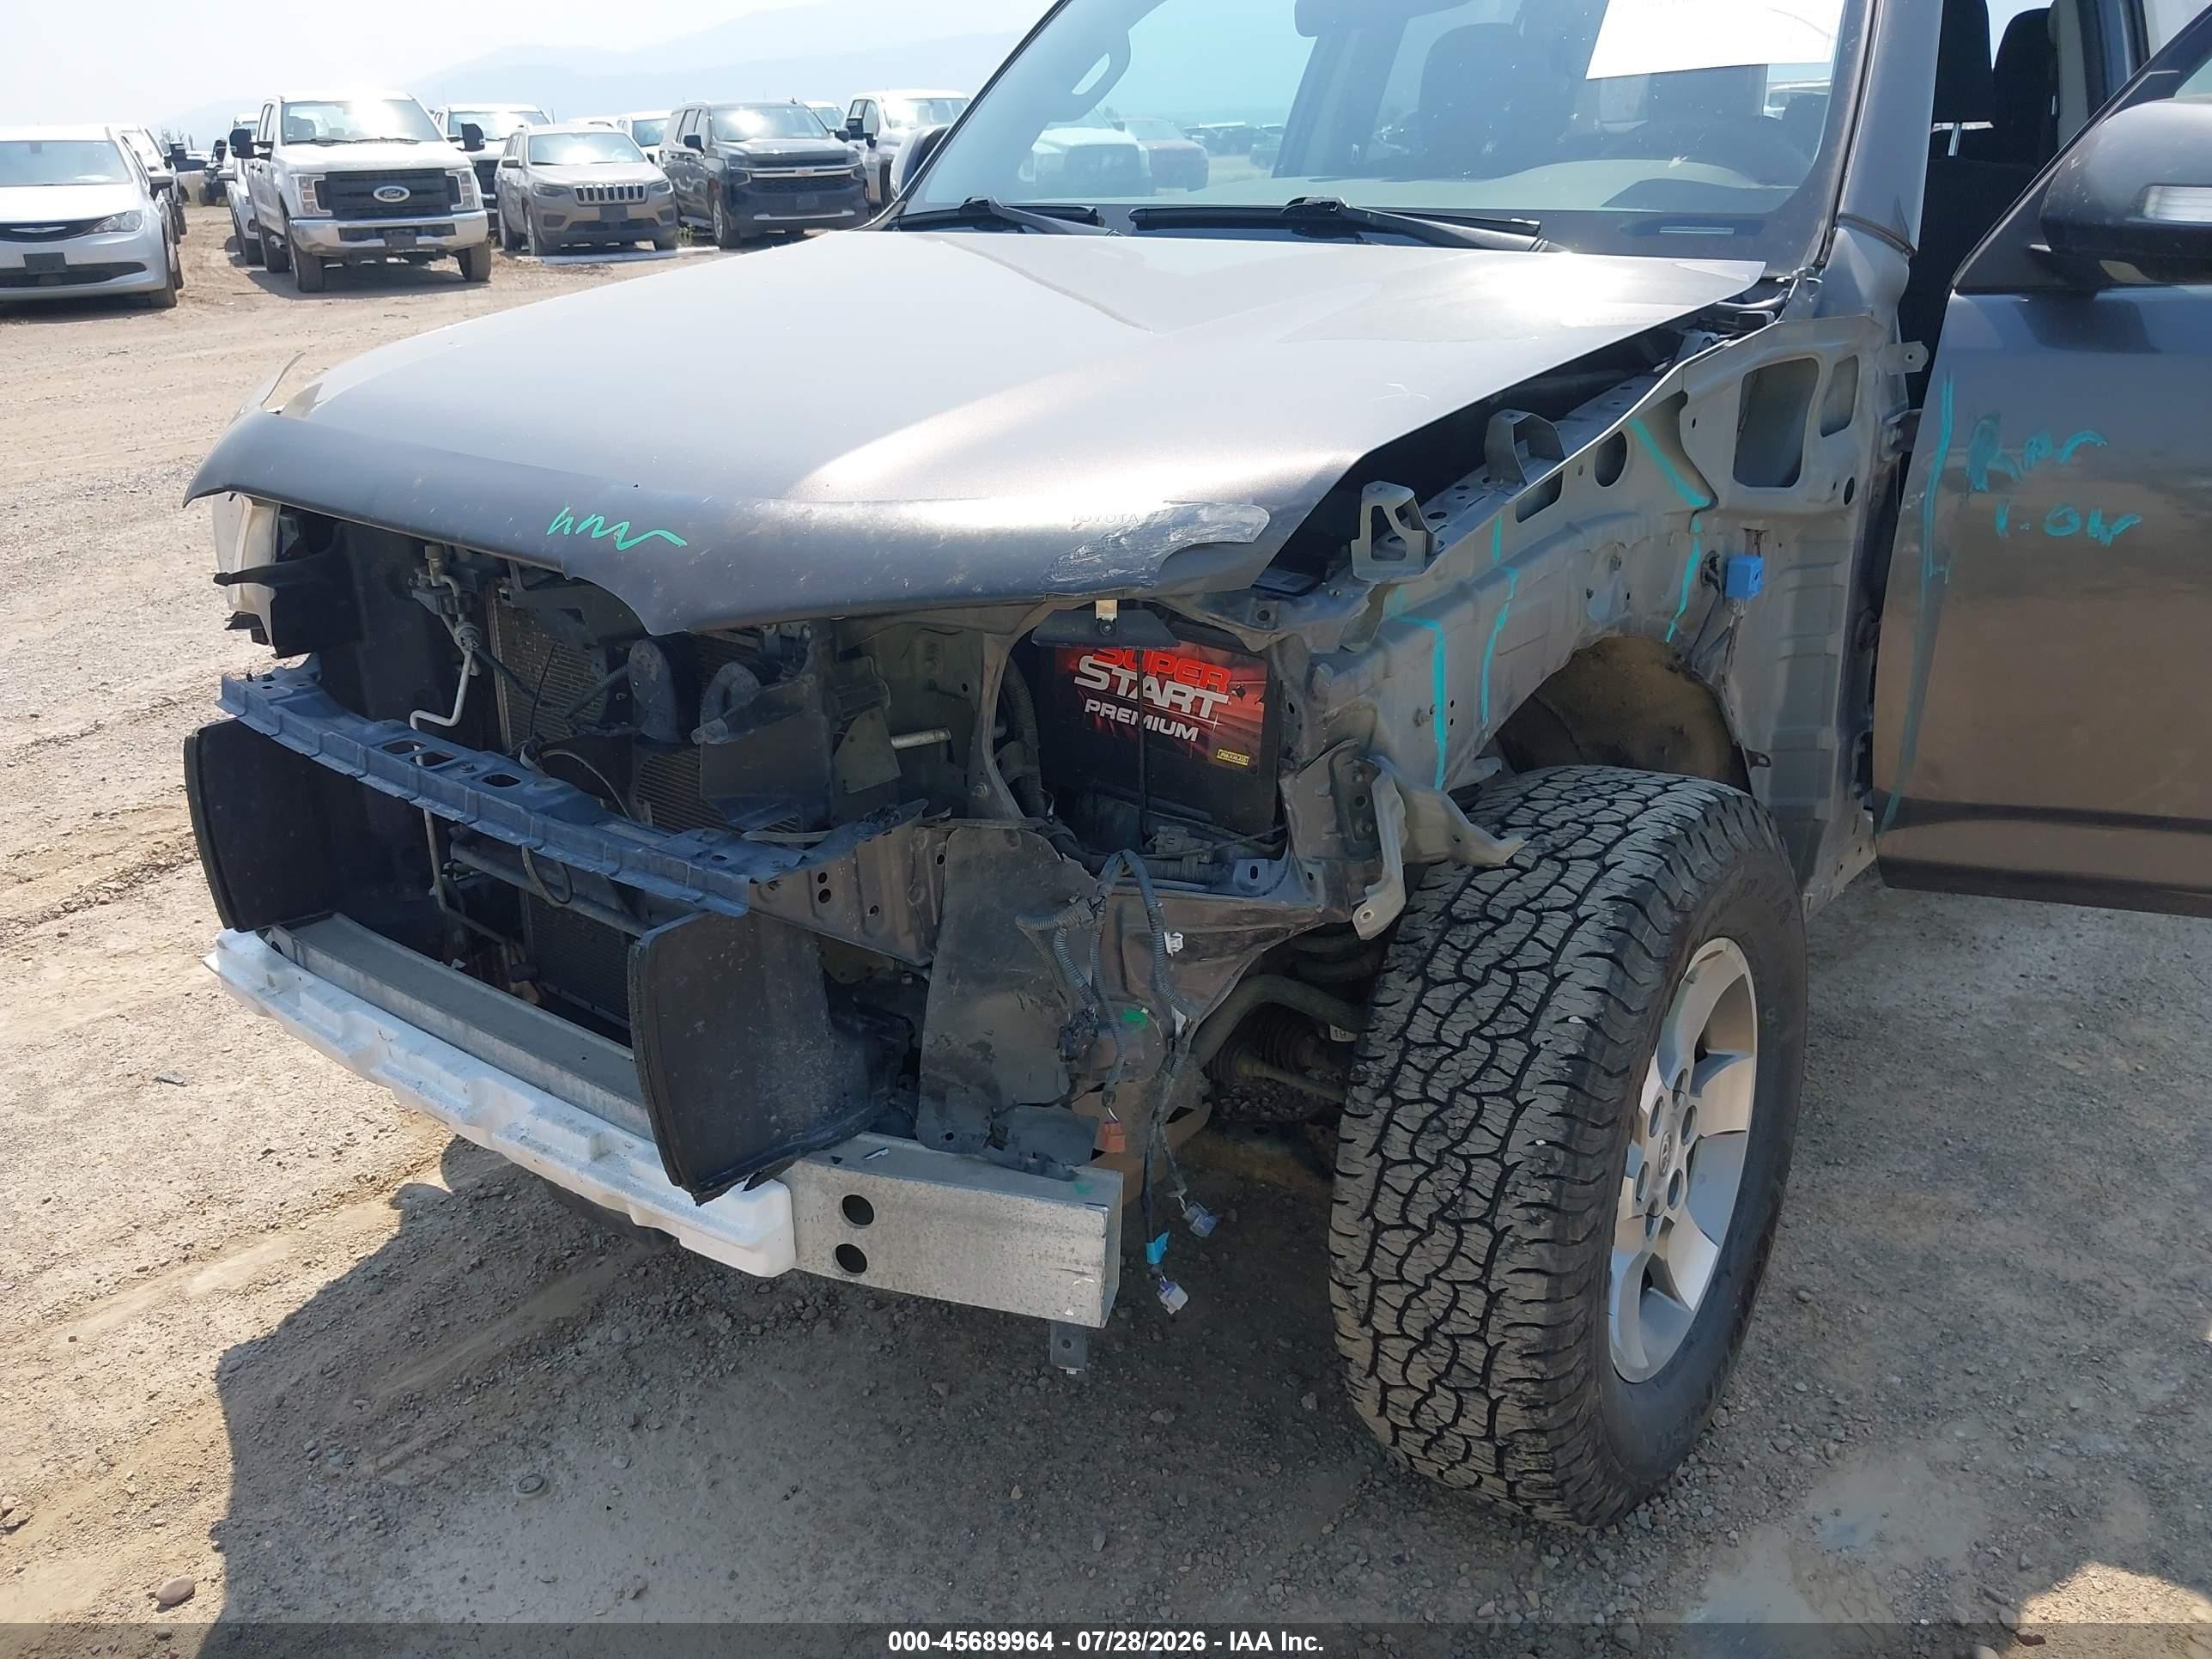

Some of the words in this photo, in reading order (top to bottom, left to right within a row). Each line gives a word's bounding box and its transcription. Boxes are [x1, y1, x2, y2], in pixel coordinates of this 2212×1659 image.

[1073, 655, 1230, 719] START
[1092, 648, 1231, 694] SUPER
[1085, 698, 1200, 742] PREMIUM
